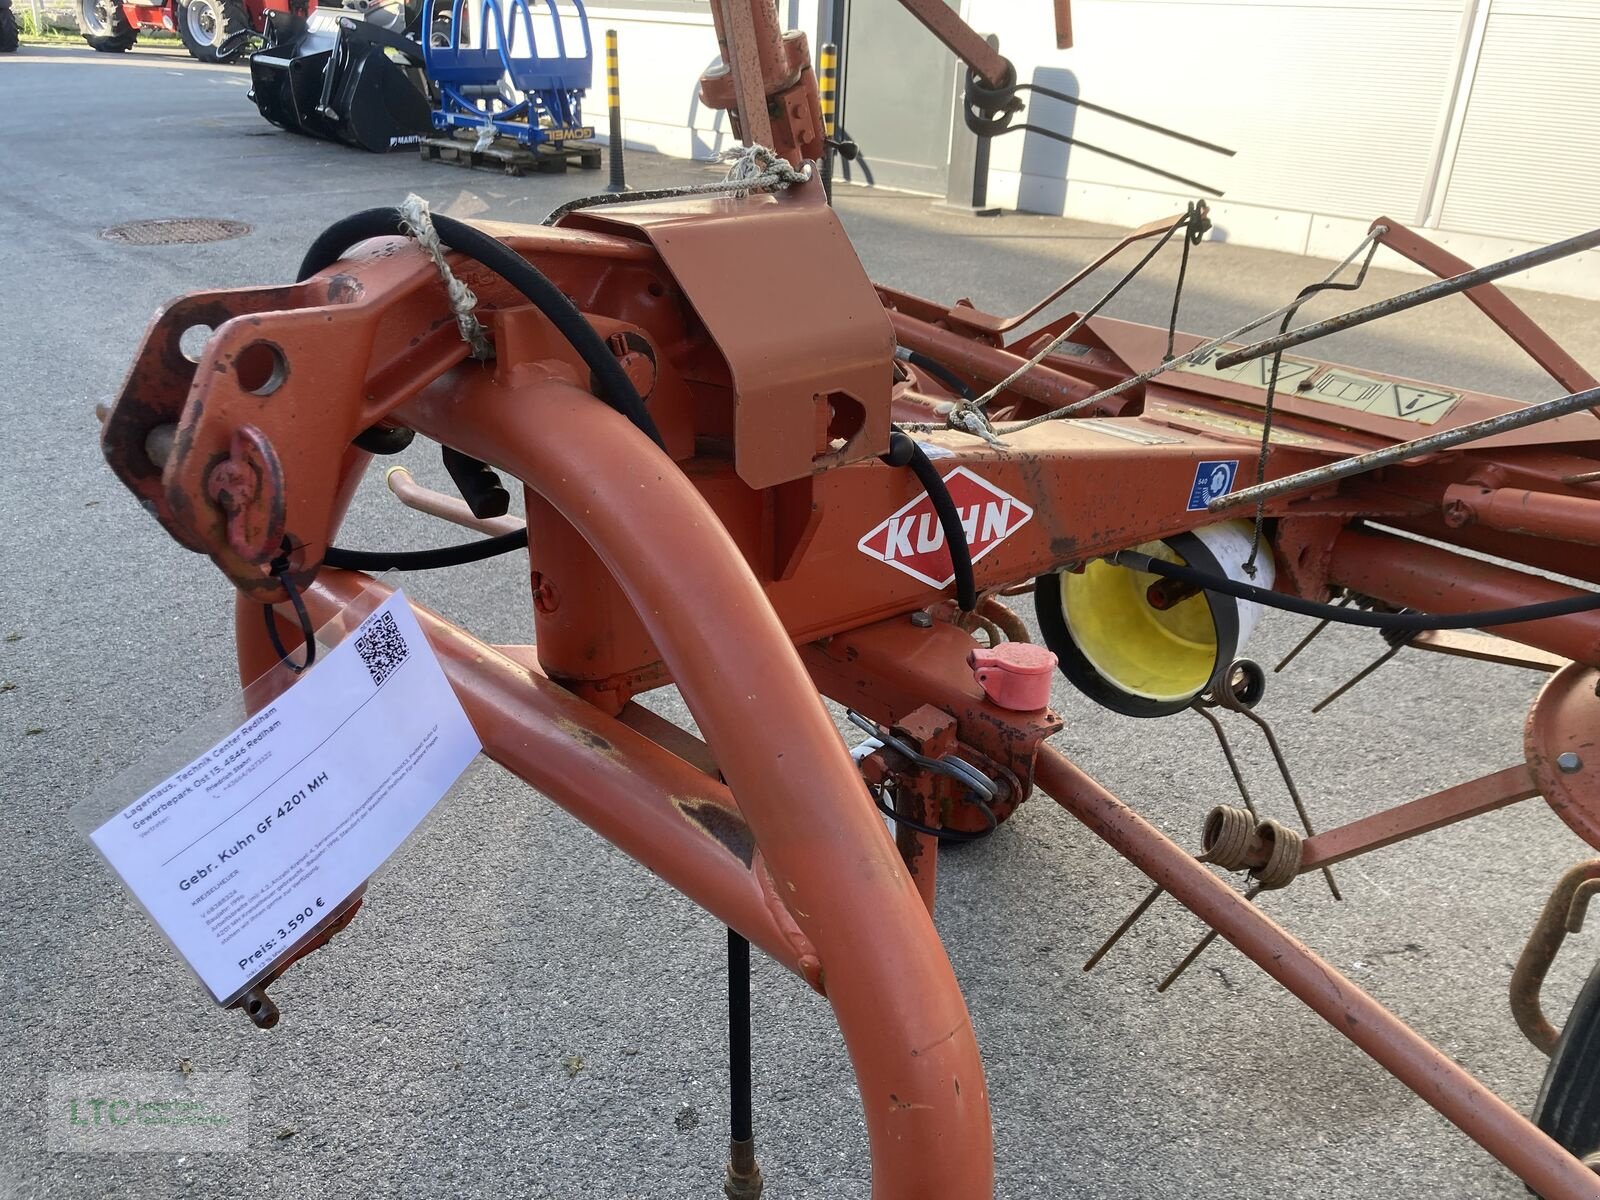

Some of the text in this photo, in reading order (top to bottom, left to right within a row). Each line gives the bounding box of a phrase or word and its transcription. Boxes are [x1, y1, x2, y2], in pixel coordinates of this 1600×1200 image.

[884, 498, 1012, 561] KUHN
[359, 613, 377, 632] DETAILS
[123, 706, 277, 819] Lagerhaus, Technik Center Redlham
[131, 785, 193, 830] Gewerbepark
[192, 772, 210, 788] Ost
[222, 745, 247, 766] 4846
[245, 719, 281, 748] Redlham
[205, 770, 233, 792] Friedrich
[177, 770, 329, 892] Gebr. Kuhn GF 4201 MH
[191, 868, 239, 906] KREISELHEUER
[237, 896, 325, 970] Preis: 3.590 €
